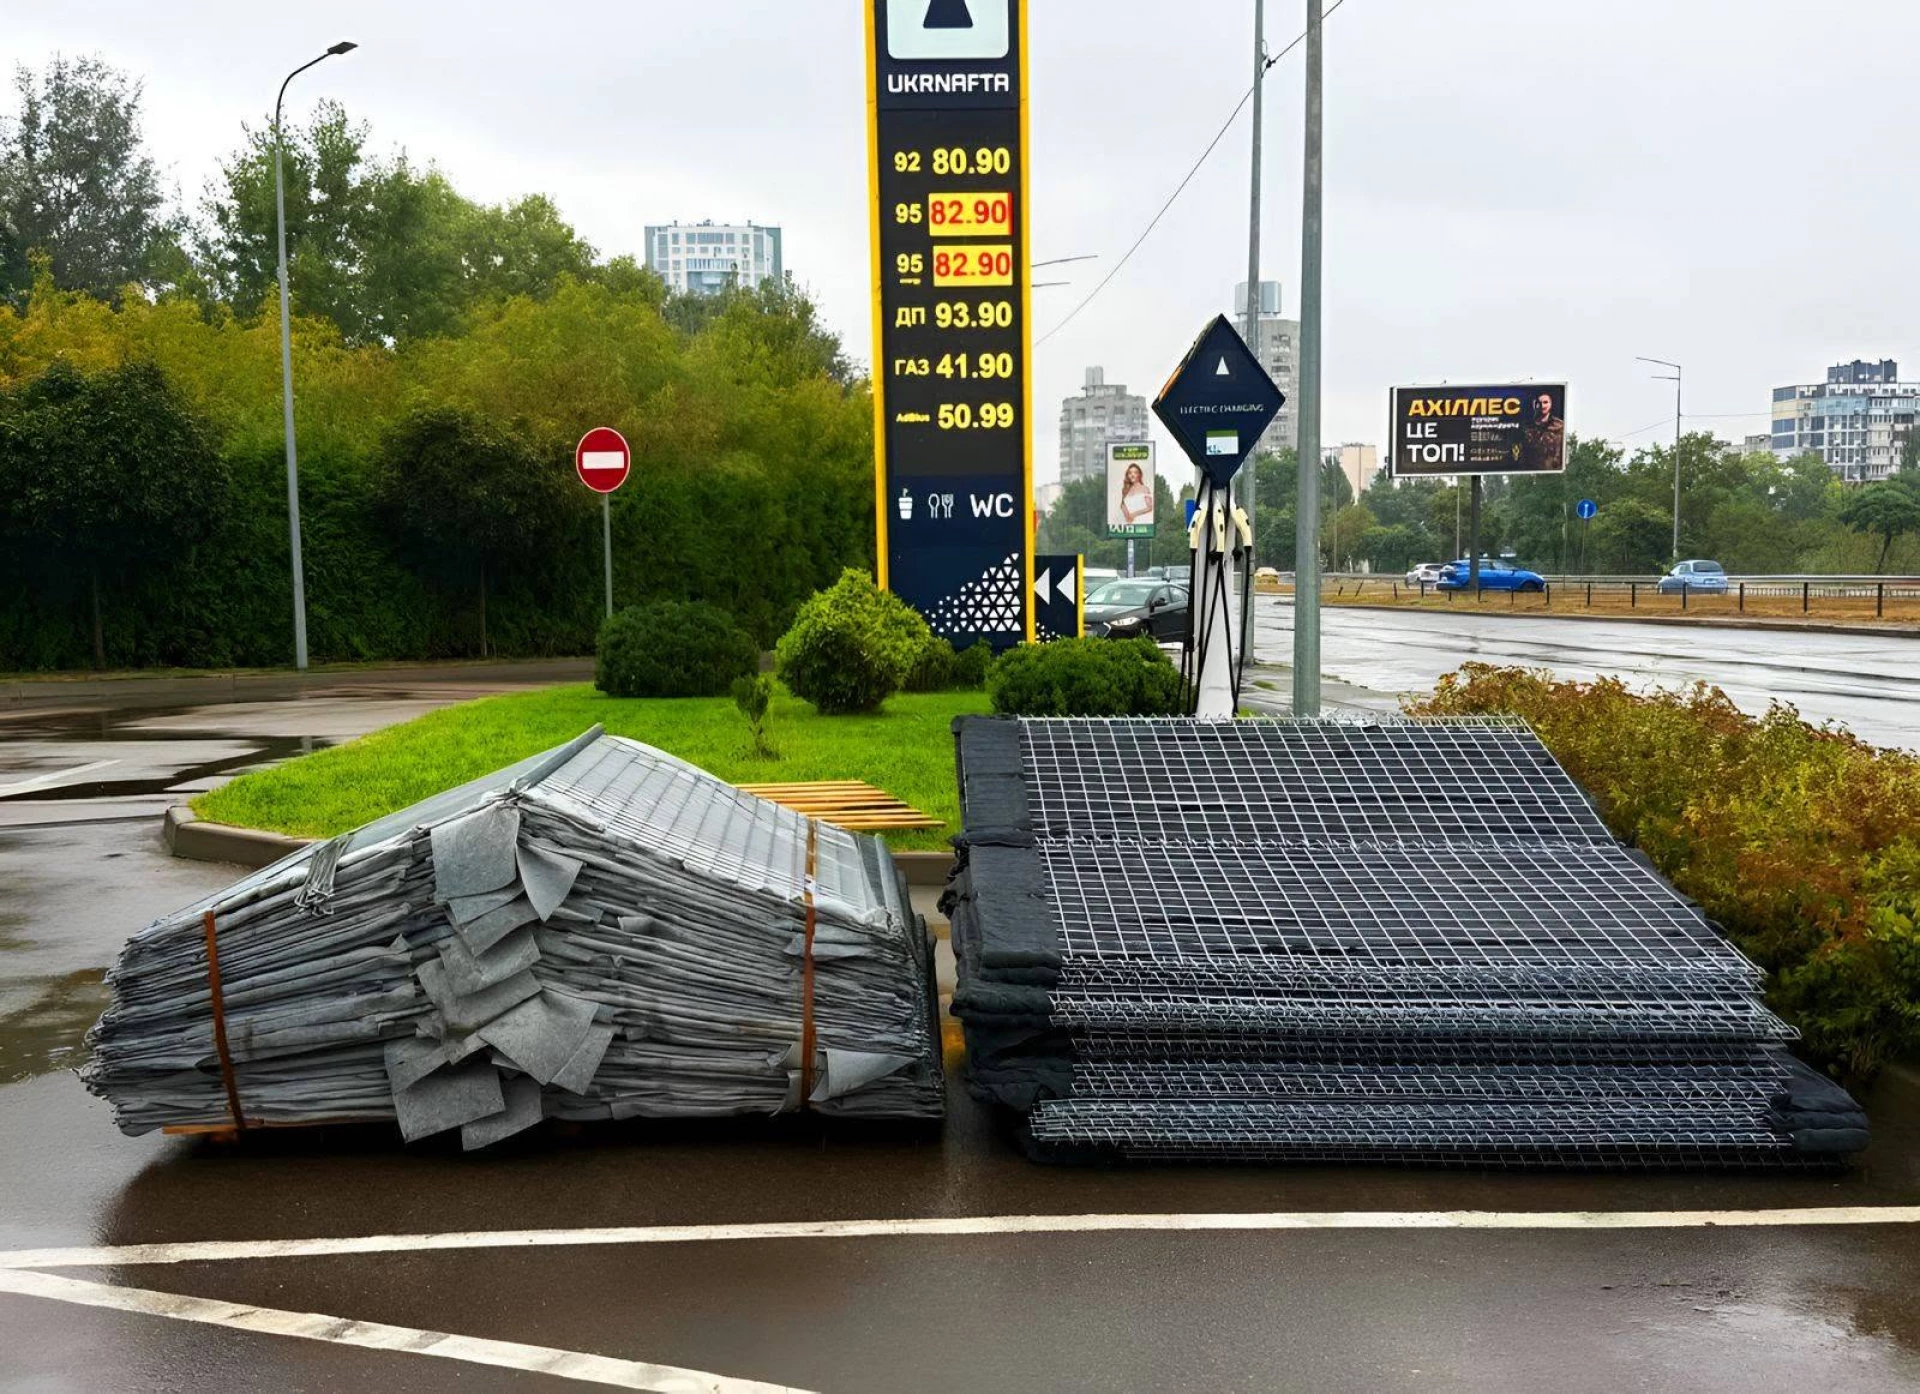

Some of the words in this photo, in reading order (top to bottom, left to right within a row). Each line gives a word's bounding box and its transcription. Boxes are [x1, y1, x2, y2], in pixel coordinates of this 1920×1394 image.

[887, 73, 1009, 93] UKRNAFTA
[894, 152, 921, 172] 92
[932, 147, 1010, 175] 80.90
[895, 203, 922, 223] 95
[931, 200, 1007, 225] 82.90
[896, 253, 923, 273] 95
[935, 252, 1011, 277] 82.90
[895, 307, 926, 328] ДП
[935, 301, 1013, 328] 93.90
[894, 359, 930, 376] ГАЗ
[936, 353, 1013, 379] 41.90
[938, 403, 1014, 429] 50.99
[1408, 398, 1521, 416] АХІЛЛЕС
[1406, 422, 1438, 439] ЦЕ
[1406, 443, 1465, 463] ТОП!
[969, 493, 1014, 518] WC
